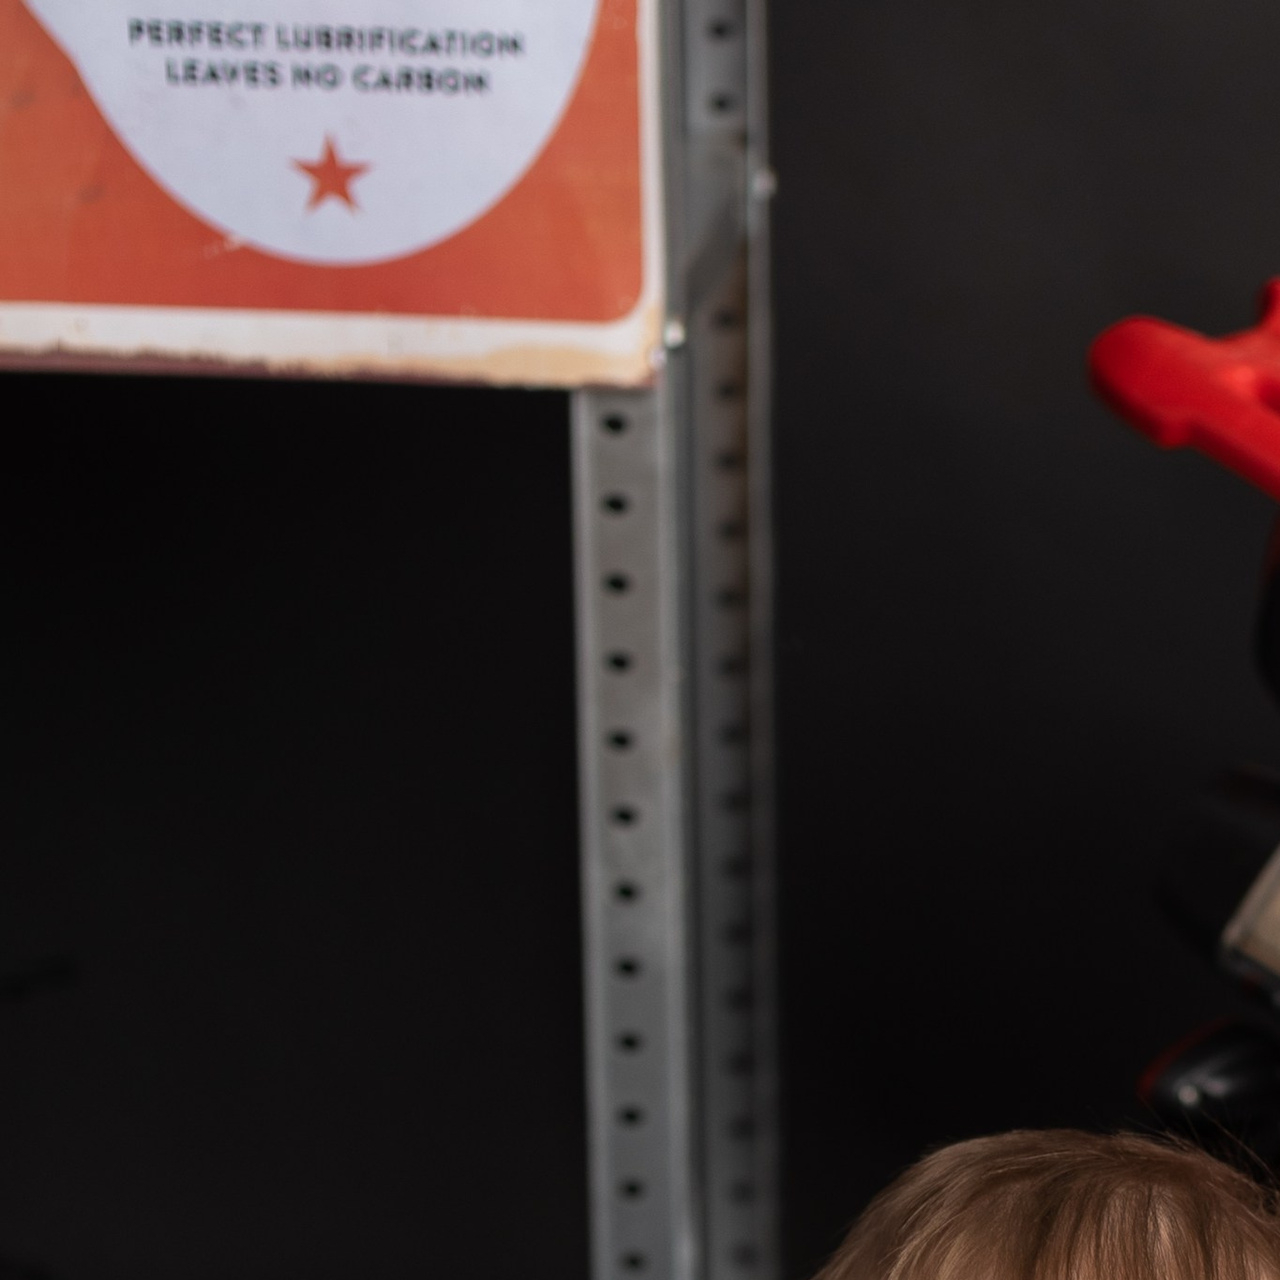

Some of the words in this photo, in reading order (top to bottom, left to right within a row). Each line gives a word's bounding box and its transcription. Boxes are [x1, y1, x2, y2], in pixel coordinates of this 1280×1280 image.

[129, 19, 267, 48] PERFECT
[275, 22, 525, 56] LUBRIFICATION
[165, 58, 279, 88] LEAVES
[291, 61, 344, 93] NO
[352, 63, 491, 96] CARBON
